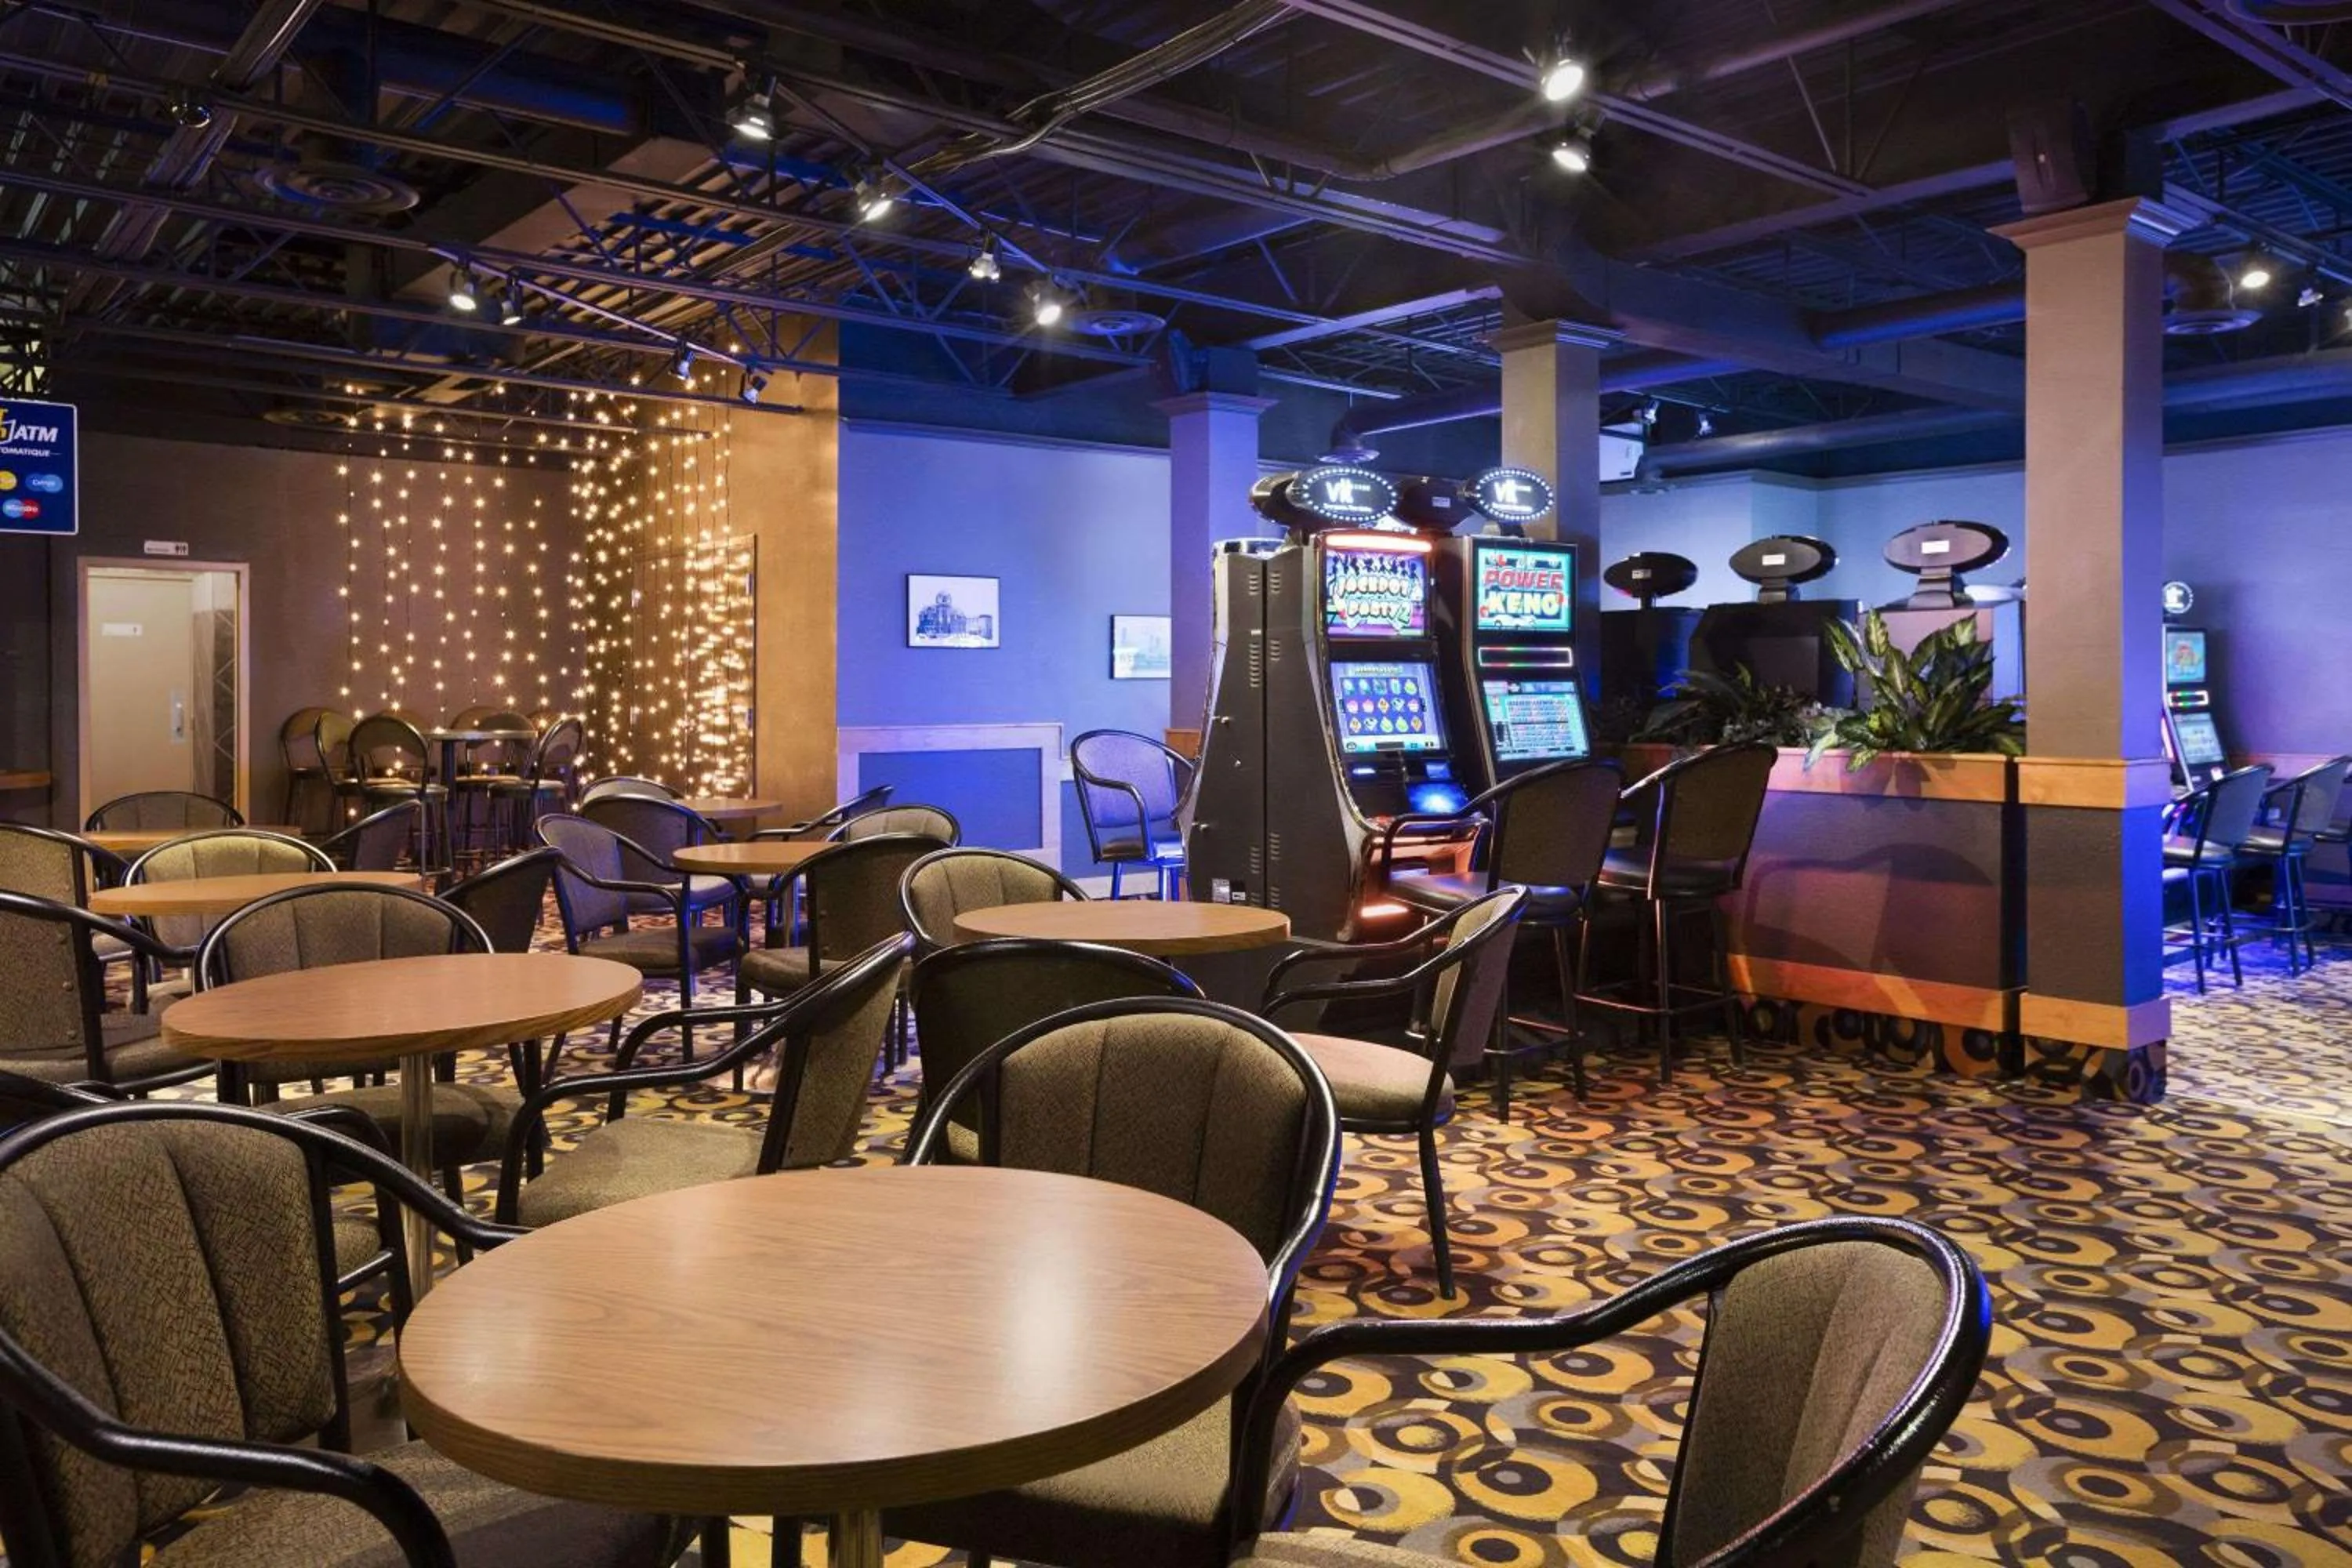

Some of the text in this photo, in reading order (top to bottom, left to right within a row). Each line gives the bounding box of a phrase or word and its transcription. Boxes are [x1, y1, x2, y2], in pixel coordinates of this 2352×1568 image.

[13, 424, 59, 443] ATM
[1484, 569, 1564, 591] POWER
[1486, 591, 1563, 616] KENO
